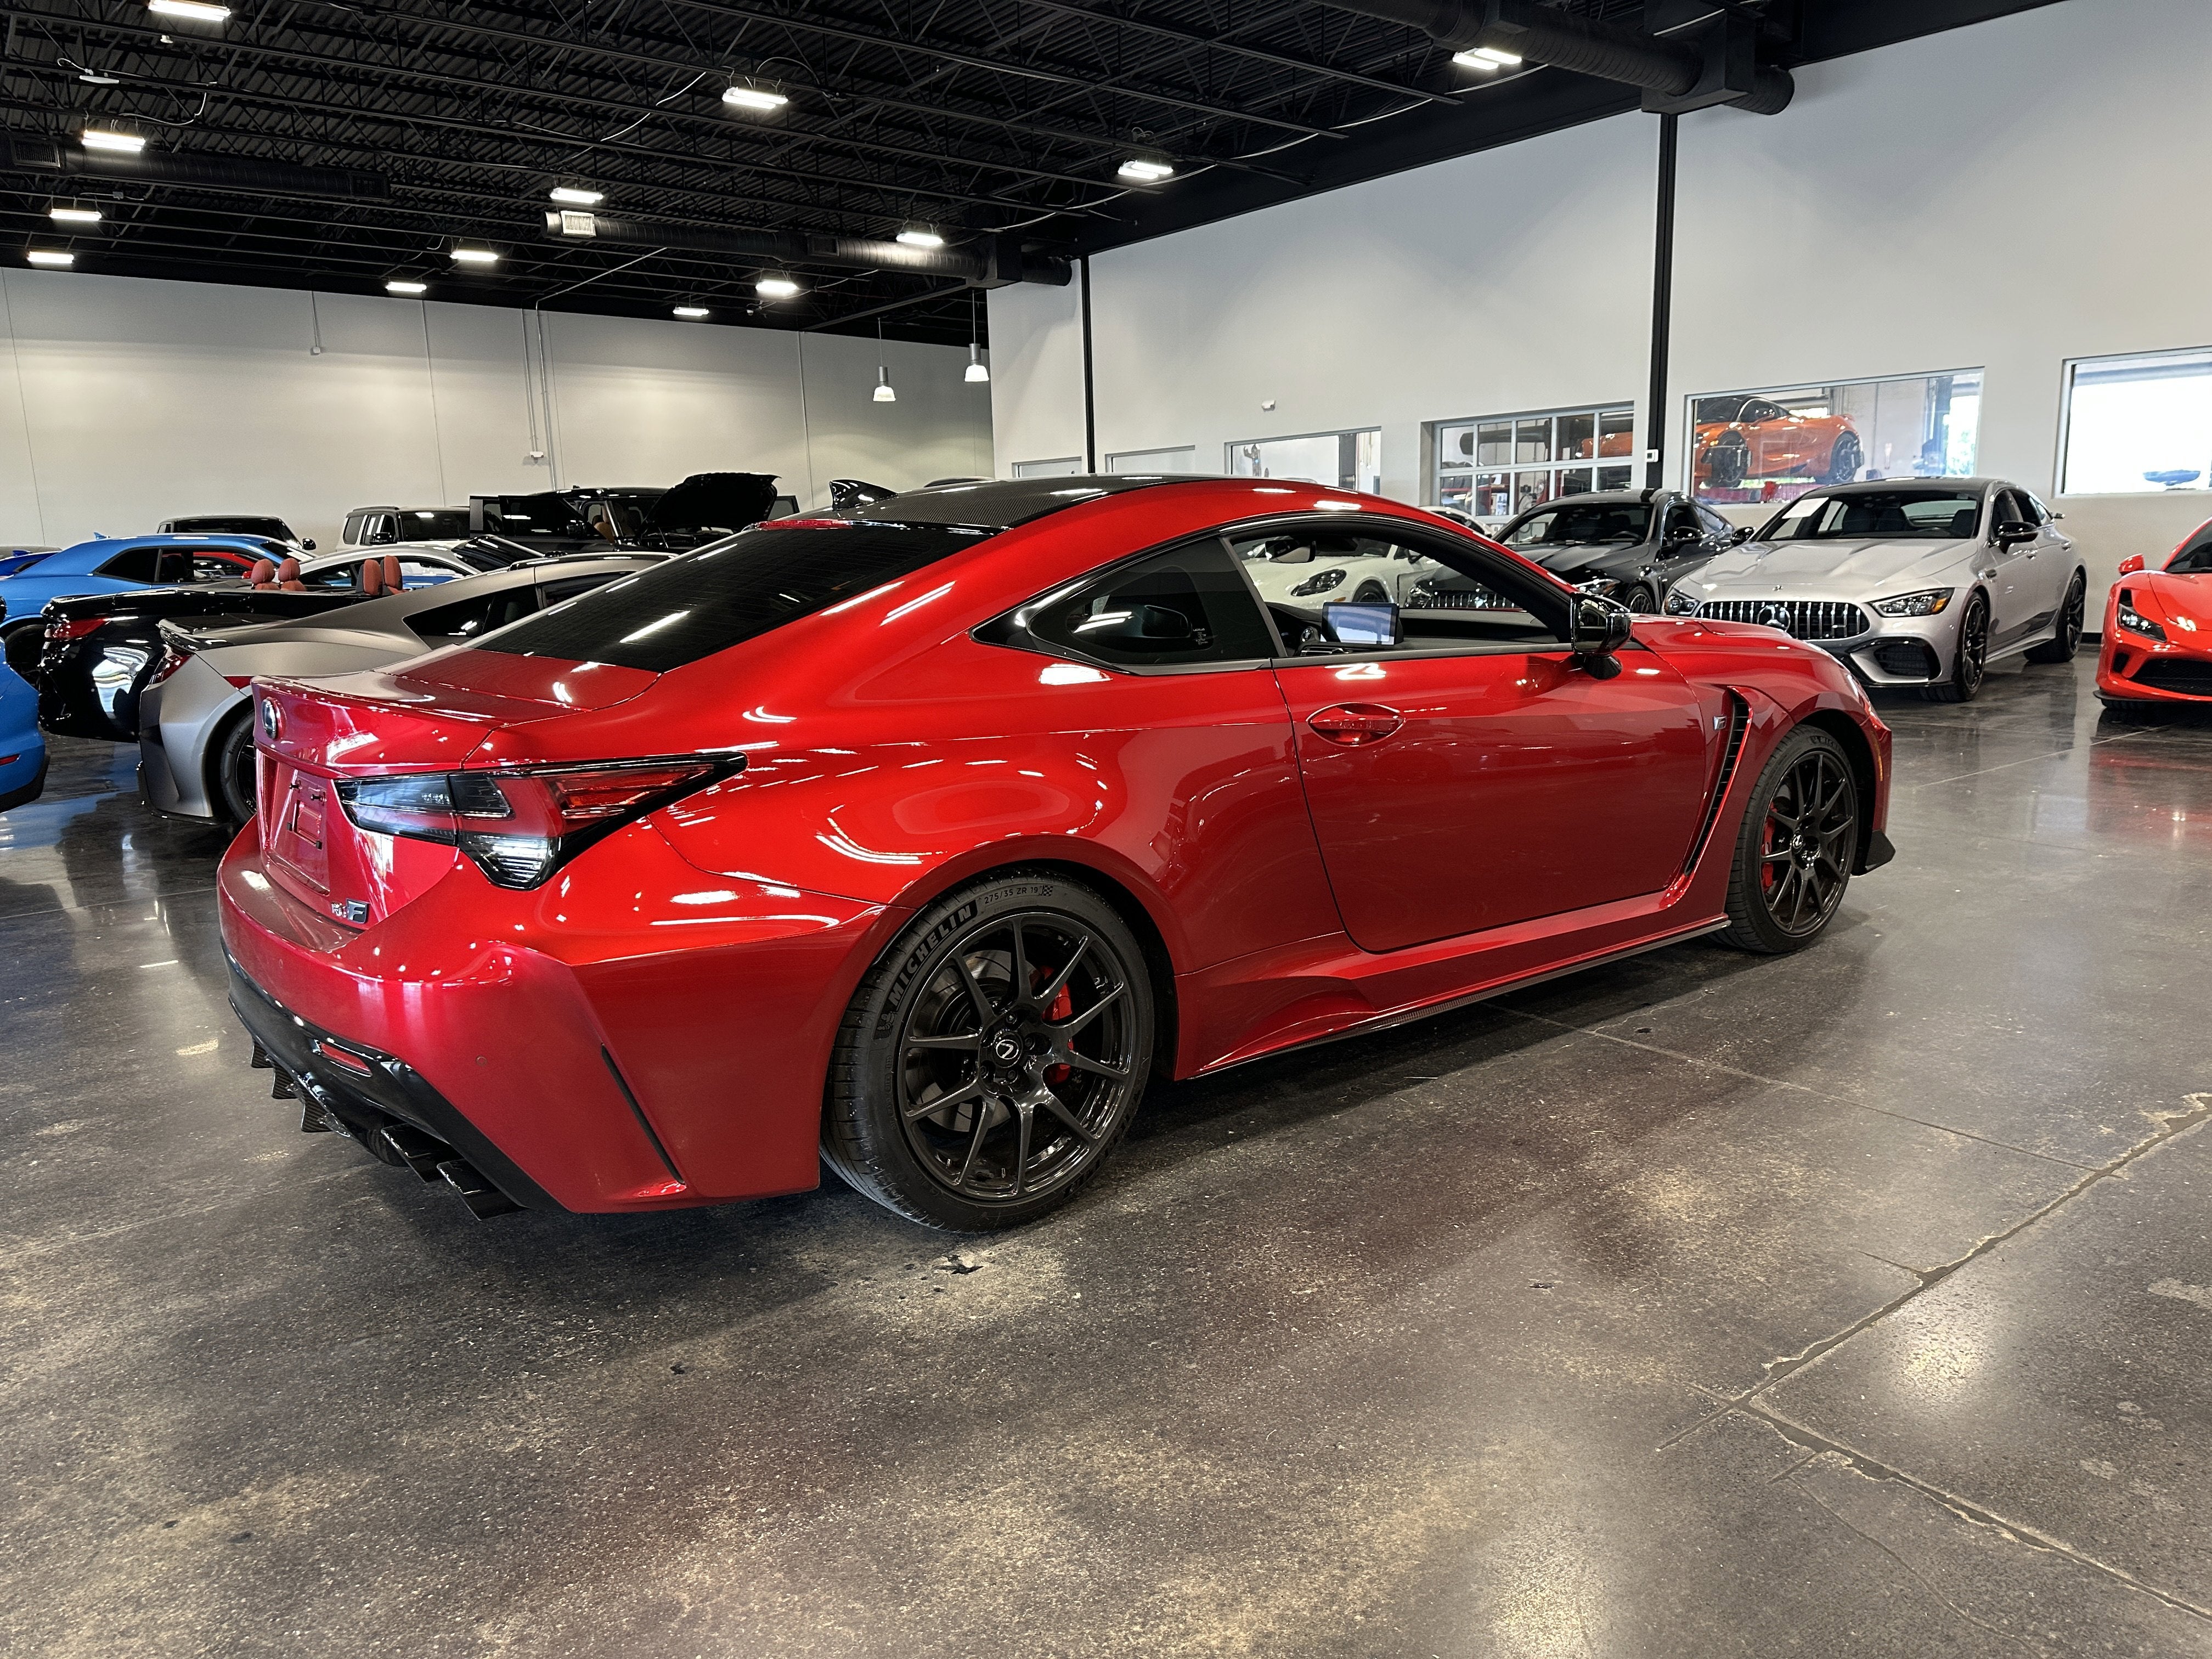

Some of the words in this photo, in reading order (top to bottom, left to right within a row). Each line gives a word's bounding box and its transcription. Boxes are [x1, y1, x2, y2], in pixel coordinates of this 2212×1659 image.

[1713, 715, 1727, 730] F
[984, 888, 1014, 904] 275/35
[1017, 887, 1028, 895] ZR
[347, 900, 366, 922] F
[888, 904, 972, 1007] MICHELIN
